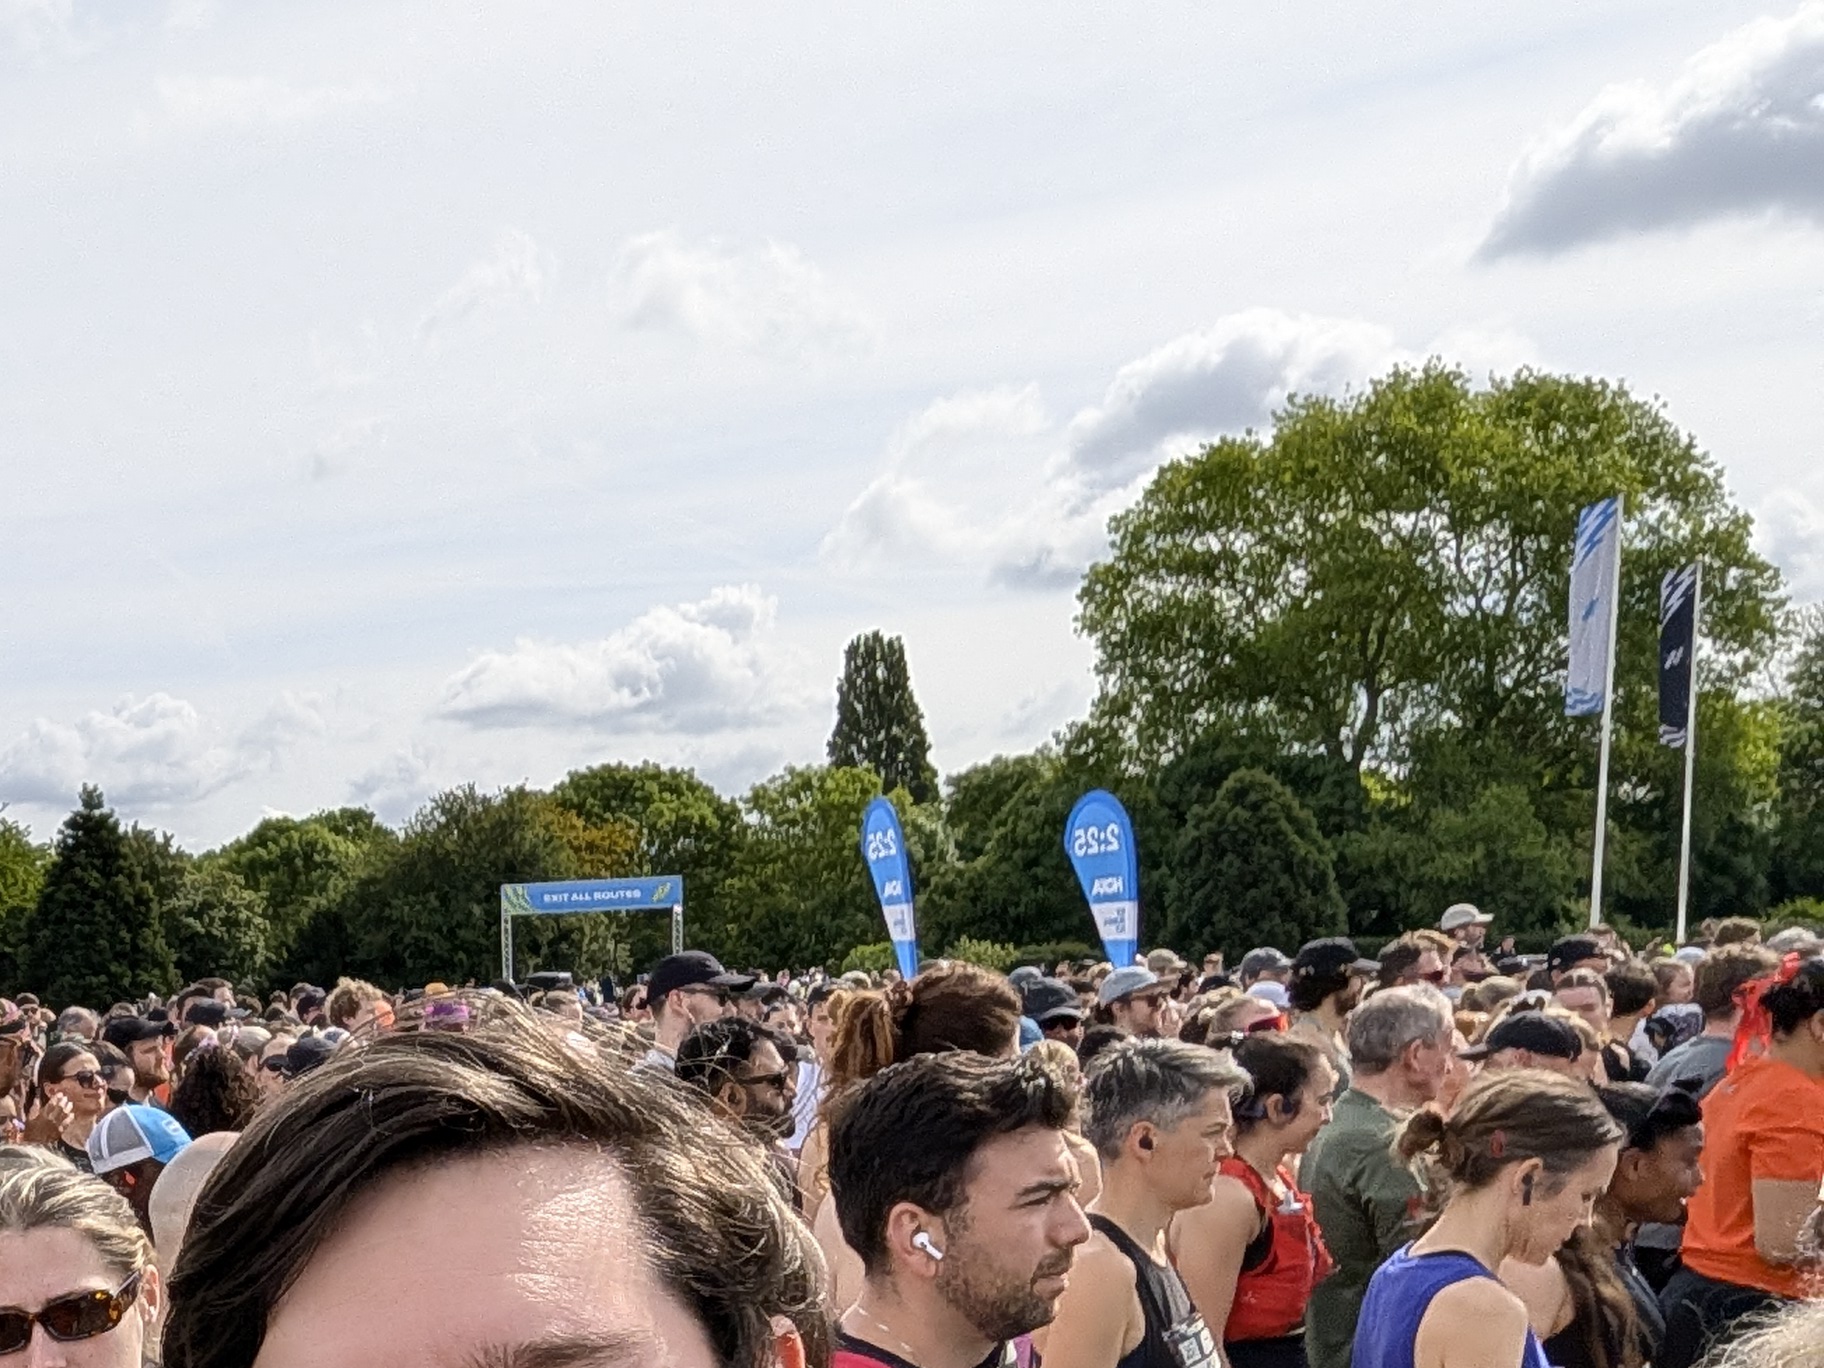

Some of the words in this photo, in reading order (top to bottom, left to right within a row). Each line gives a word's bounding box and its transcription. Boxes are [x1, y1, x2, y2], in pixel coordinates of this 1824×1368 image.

[543, 892, 568, 903] EXIT
[571, 891, 592, 901] ALL
[594, 888, 642, 900] ROUTES
